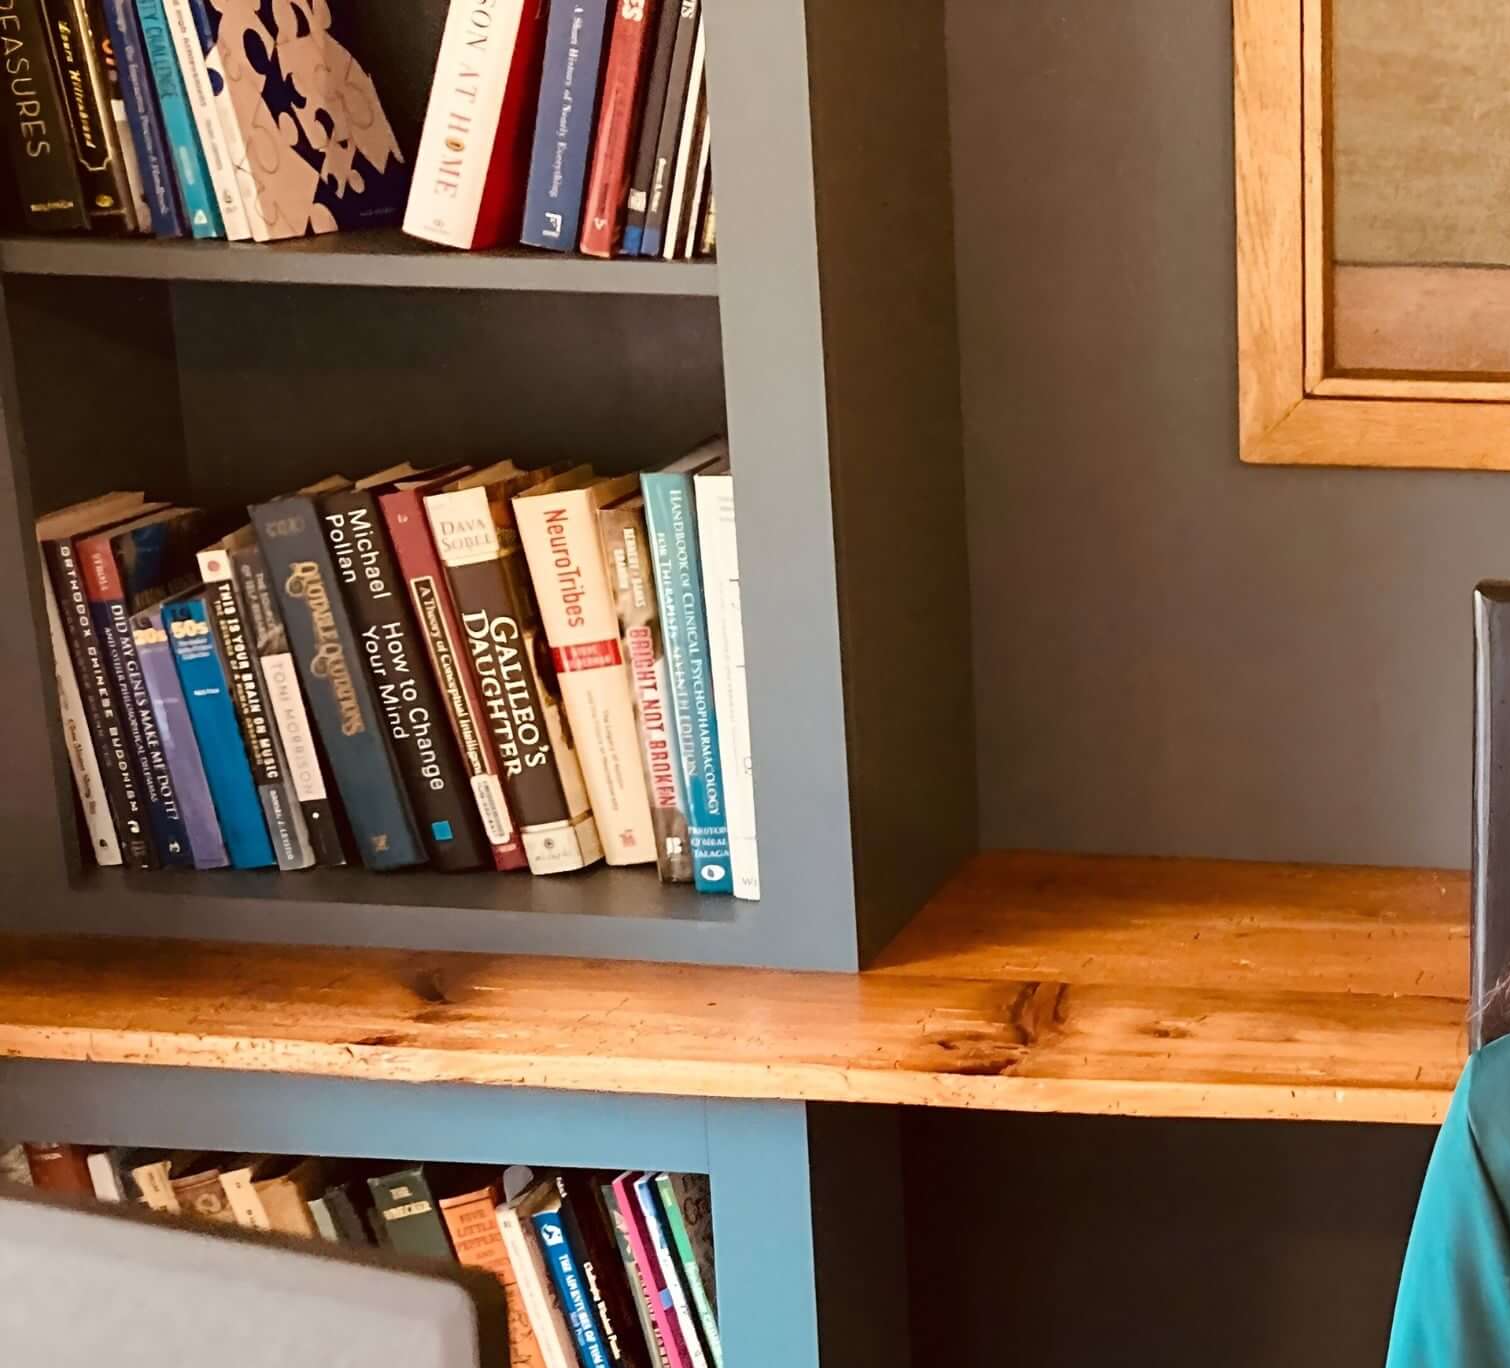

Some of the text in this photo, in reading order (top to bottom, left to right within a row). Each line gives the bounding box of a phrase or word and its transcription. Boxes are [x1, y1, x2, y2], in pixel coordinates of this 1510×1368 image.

[453, 62, 481, 104] AT
[562, 88, 574, 101] of
[564, 48, 580, 87] History
[434, 111, 473, 199] HOME
[556, 102, 572, 138] Nearly
[548, 140, 570, 198] Everything
[325, 514, 357, 584] Pollan
[348, 509, 392, 600] Michael
[440, 518, 486, 537] DAVA
[441, 533, 492, 551] SOBEL
[543, 508, 586, 629] NeuroTribes
[669, 489, 689, 572] HANDBOOK
[285, 561, 365, 737] QUOTABLE QUOTATIONS
[419, 585, 470, 719] A Theory of Conceptual
[682, 592, 701, 655] CLINICAL
[61, 546, 92, 638] ORTHODOX
[87, 646, 114, 719] CHINESE
[109, 726, 139, 812] BUDDHISM
[103, 627, 159, 803] AND OTHER PHILOSOPHICAL DILEMMAS
[111, 604, 180, 821] DID MY GENES MAKE ME DO IT?
[218, 583, 279, 779] THIS IS YOUR BRAIN ON MUSIC
[362, 625, 411, 740] Your Mind
[382, 622, 445, 791] How to Change
[462, 609, 523, 778] DAUGHTER
[489, 615, 550, 768] GALILEO'S
[629, 627, 678, 808] BRIGHT NOT BROKEN
[270, 662, 314, 795] TONI MORRISON
[690, 658, 721, 817] PSYCHOPHARMACOLOGY
[558, 1254, 571, 1272] THE
[565, 1273, 593, 1331] ADVENTURES
[582, 1330, 597, 1344] OF
[588, 1344, 602, 1364] TOM
